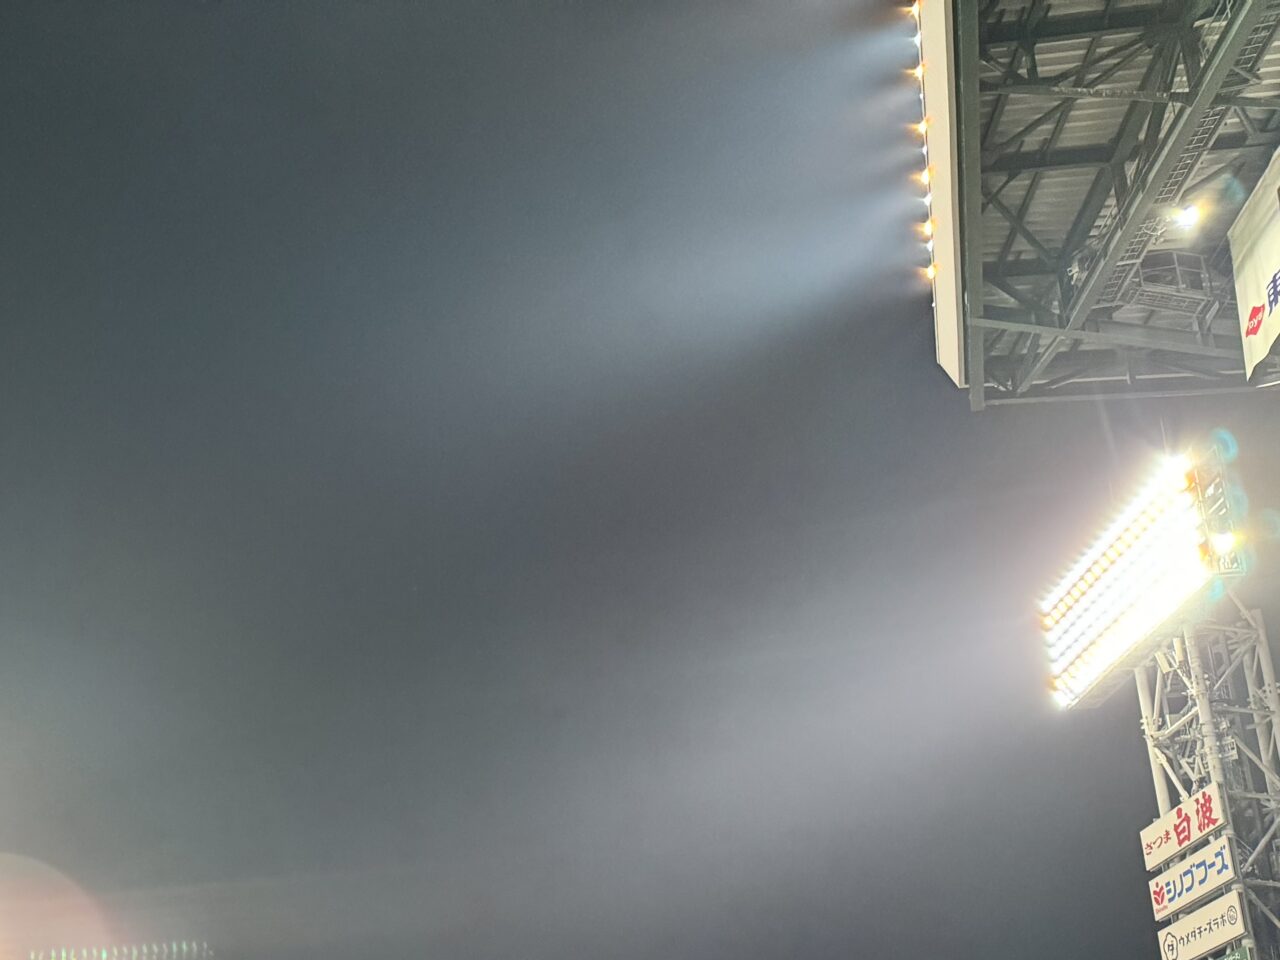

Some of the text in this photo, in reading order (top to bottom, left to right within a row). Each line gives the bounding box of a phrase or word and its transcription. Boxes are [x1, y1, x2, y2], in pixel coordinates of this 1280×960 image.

[1145, 791, 1219, 856] さつま 白波
[1165, 844, 1229, 904] シノブフーズ
